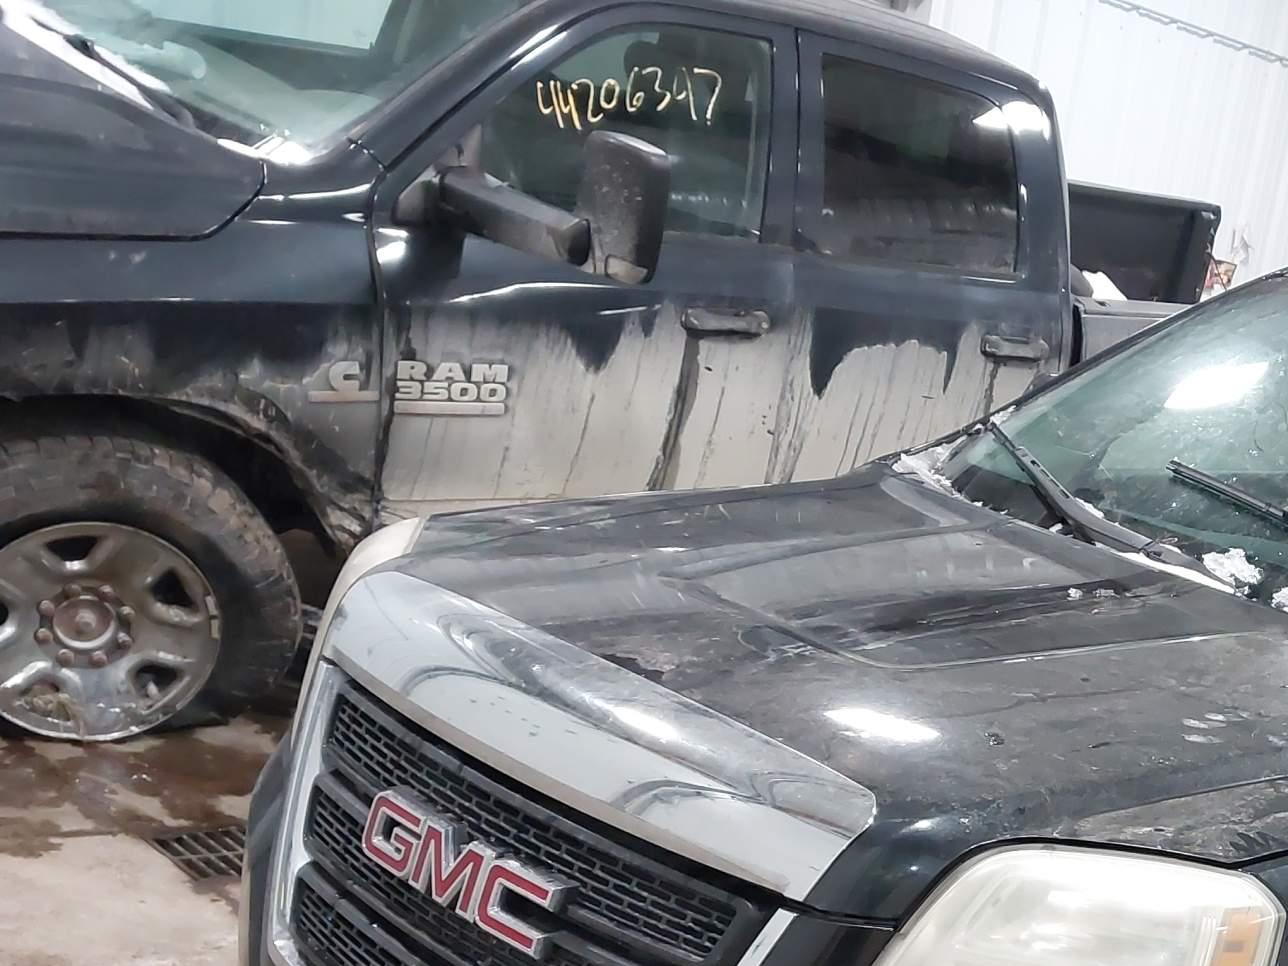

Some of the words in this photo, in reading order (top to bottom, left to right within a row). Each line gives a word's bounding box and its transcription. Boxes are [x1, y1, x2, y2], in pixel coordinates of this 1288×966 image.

[397, 360, 508, 382] RAM
[394, 381, 507, 402] 3500
[362, 790, 562, 960] GMC
